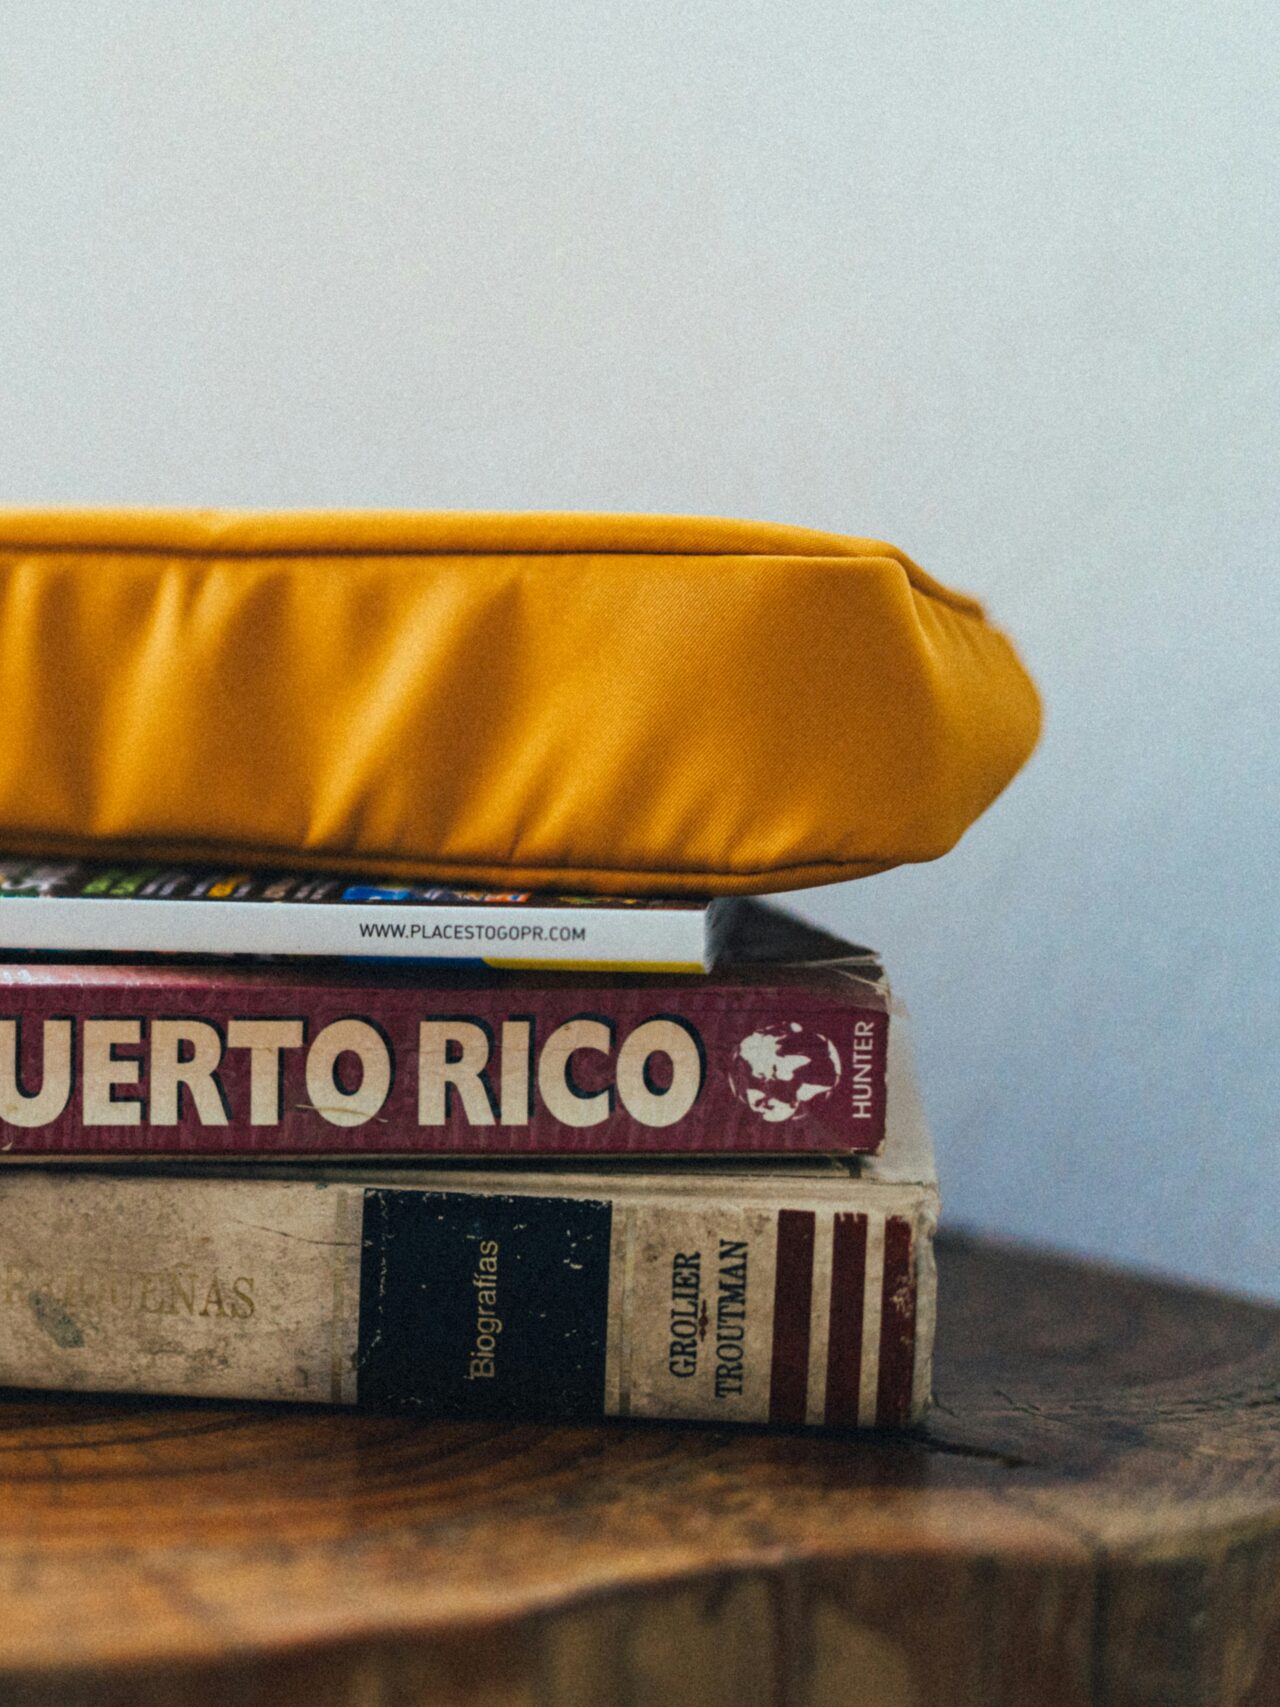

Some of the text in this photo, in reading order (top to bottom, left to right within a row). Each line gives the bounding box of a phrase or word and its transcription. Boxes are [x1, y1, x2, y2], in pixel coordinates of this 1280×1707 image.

[359, 922, 586, 942] WWW.PLACESTOGOPR.COM
[417, 1016, 705, 1128] RICO
[851, 1020, 875, 1119] HUNTER
[469, 1240, 503, 1379] Biografías
[669, 1251, 701, 1379] GROLIER
[714, 1239, 749, 1398] TROUTMAN
